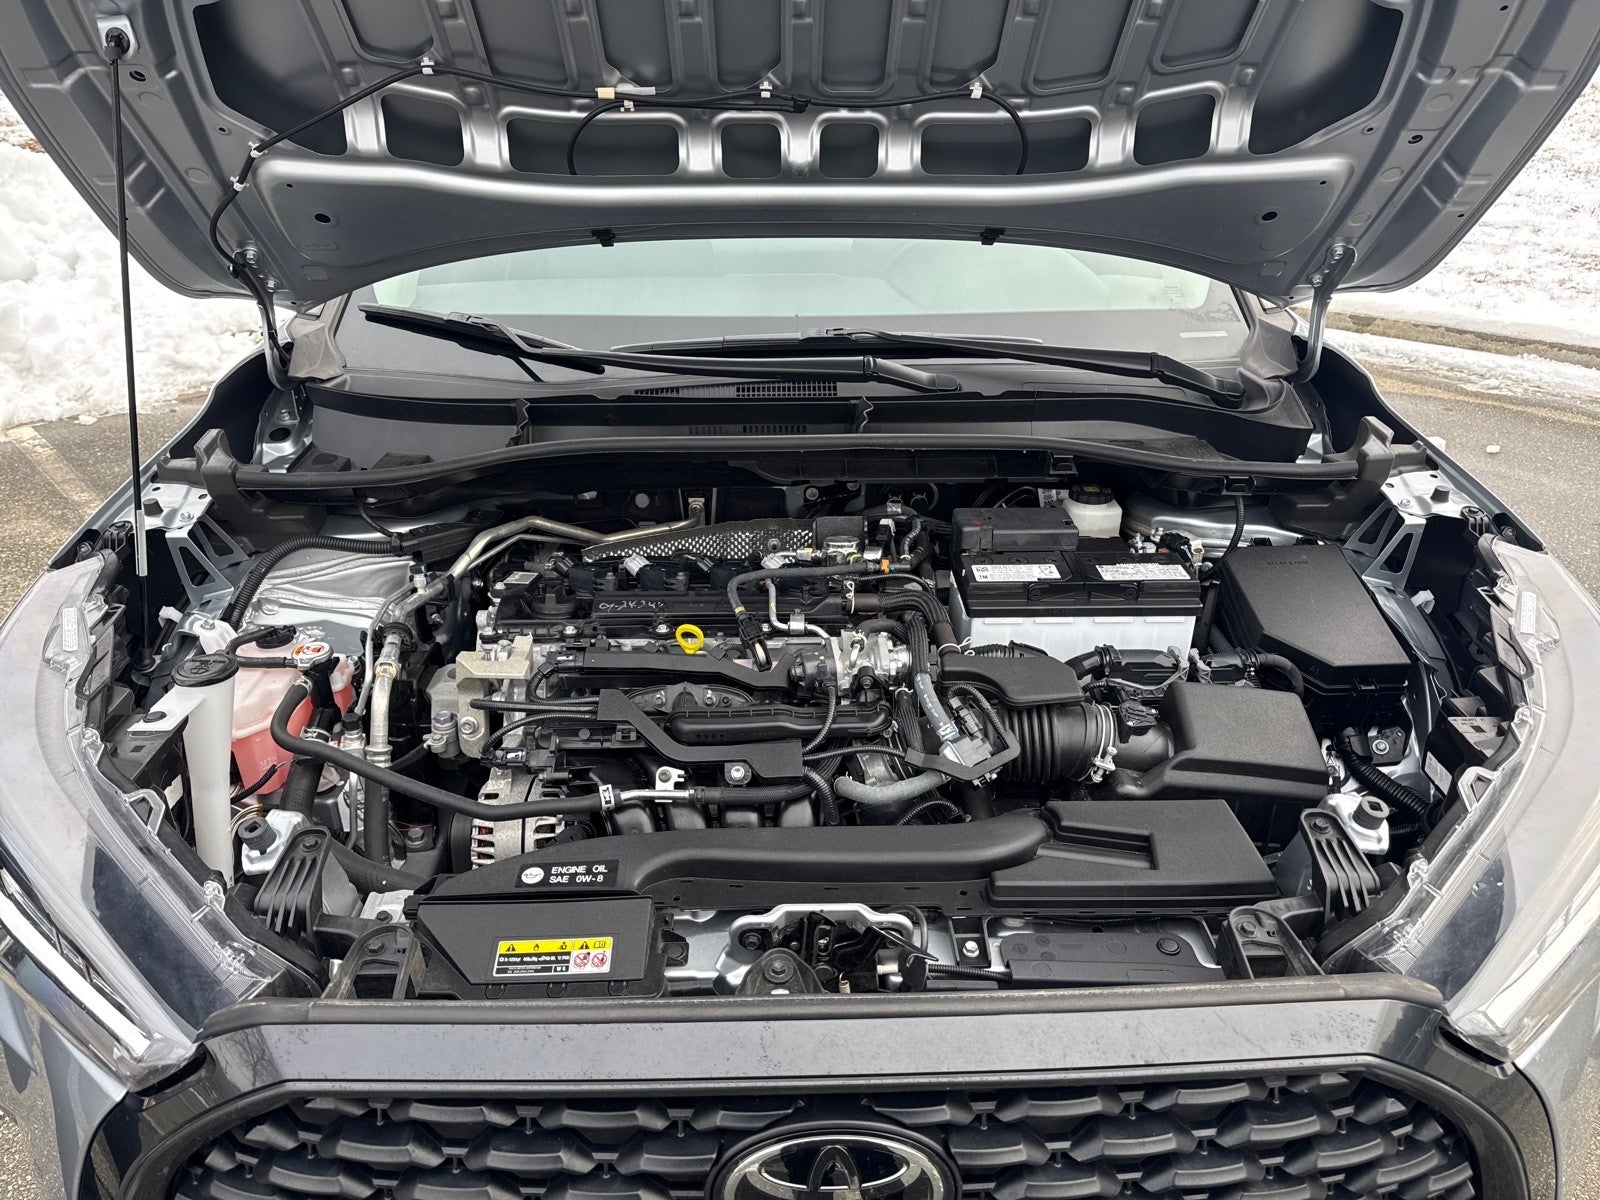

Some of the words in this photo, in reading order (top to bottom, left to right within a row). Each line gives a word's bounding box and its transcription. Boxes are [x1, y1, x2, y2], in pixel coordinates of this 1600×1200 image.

[551, 865, 587, 874] ENGINE
[592, 864, 608, 873] OIL
[549, 875, 570, 884] SAE
[575, 874, 604, 883] 0W-8
